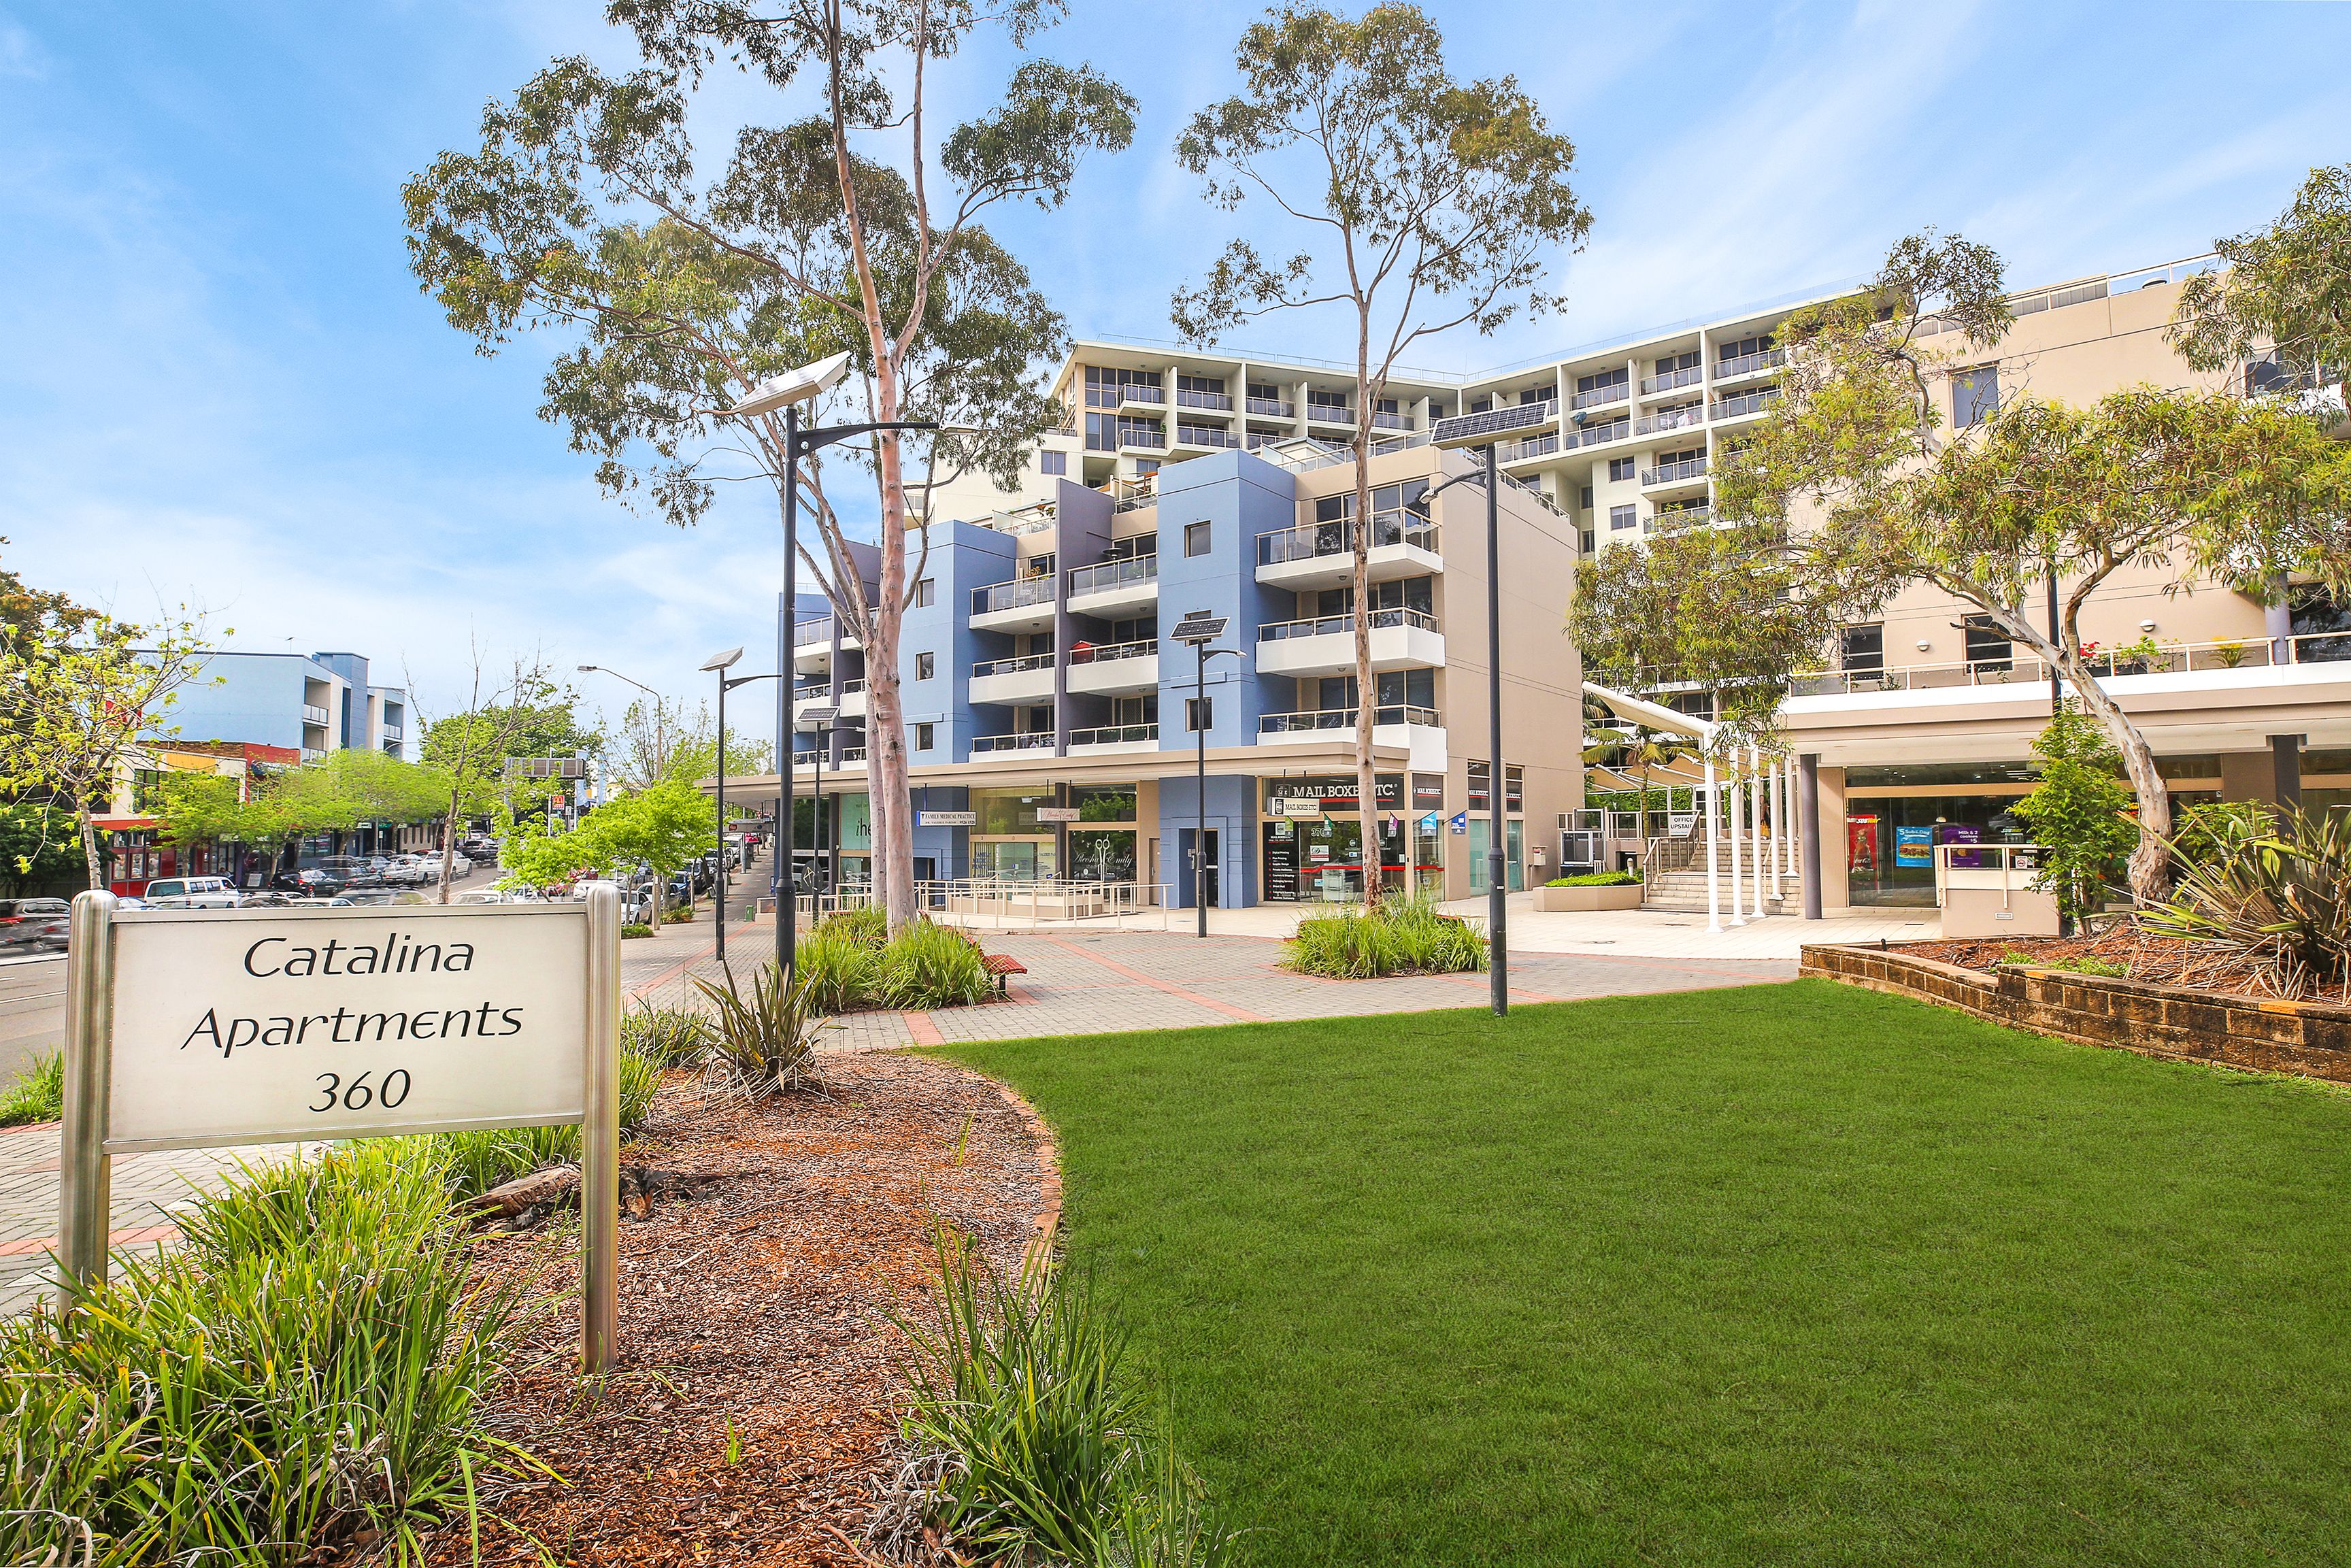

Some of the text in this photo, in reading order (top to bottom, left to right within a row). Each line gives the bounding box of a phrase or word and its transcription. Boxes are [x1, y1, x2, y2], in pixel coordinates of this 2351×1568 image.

[1291, 784, 1395, 798] MAIL BOXE TC.
[1105, 852, 1133, 869] Emily
[244, 933, 474, 978] Catalina
[180, 1001, 524, 1058] Apartments
[308, 1069, 411, 1112] 360
